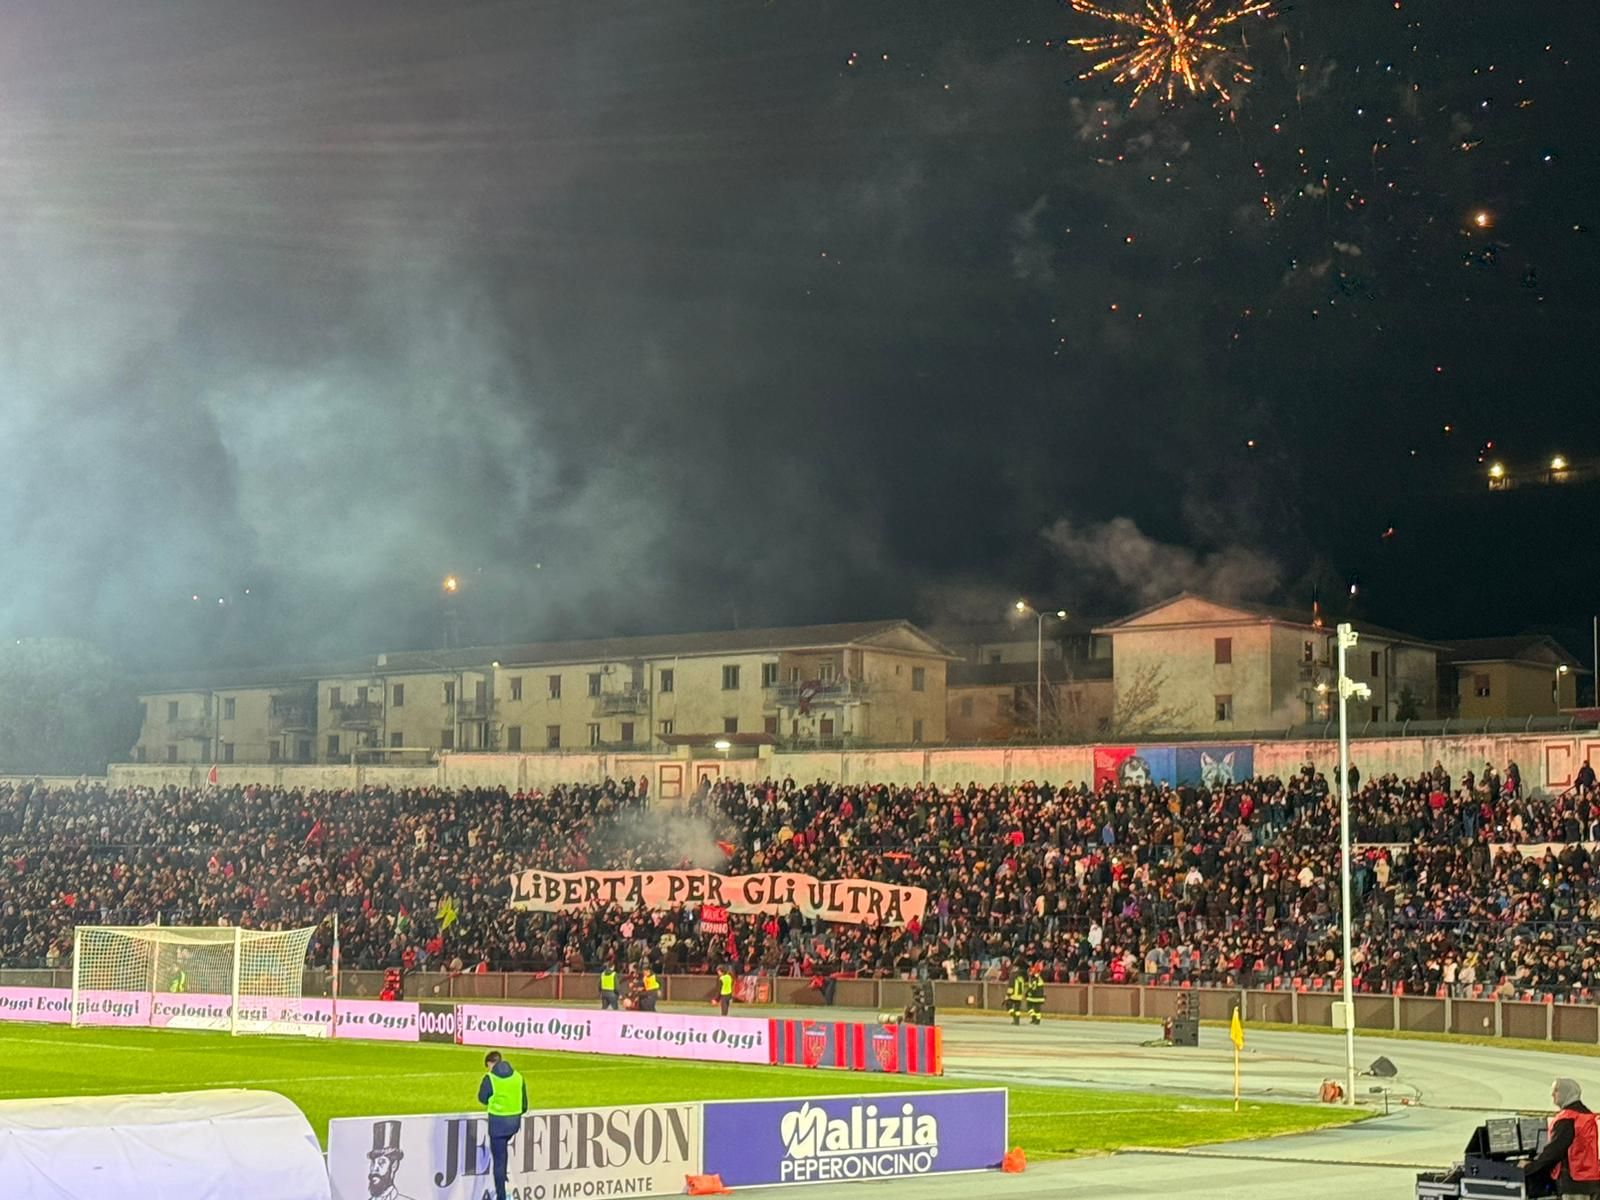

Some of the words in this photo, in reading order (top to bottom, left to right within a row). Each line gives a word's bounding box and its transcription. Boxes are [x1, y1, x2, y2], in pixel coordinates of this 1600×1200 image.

[668, 874, 730, 908] PER
[102, 999, 140, 1017] Oggi
[368, 1012, 417, 1028] Oggi
[419, 1012, 455, 1034] 00:00
[466, 1015, 544, 1037] Ecologia
[547, 1018, 592, 1040] Oggi
[620, 1024, 707, 1045] Ecologia
[712, 1028, 763, 1049] Oggi
[780, 1101, 938, 1160] Malizia
[434, 1106, 693, 1188] JEFERSON
[780, 1151, 932, 1181] PEPERONCINO
[481, 1184, 546, 1200] AARO
[553, 1177, 653, 1198] IMPORTANTE
